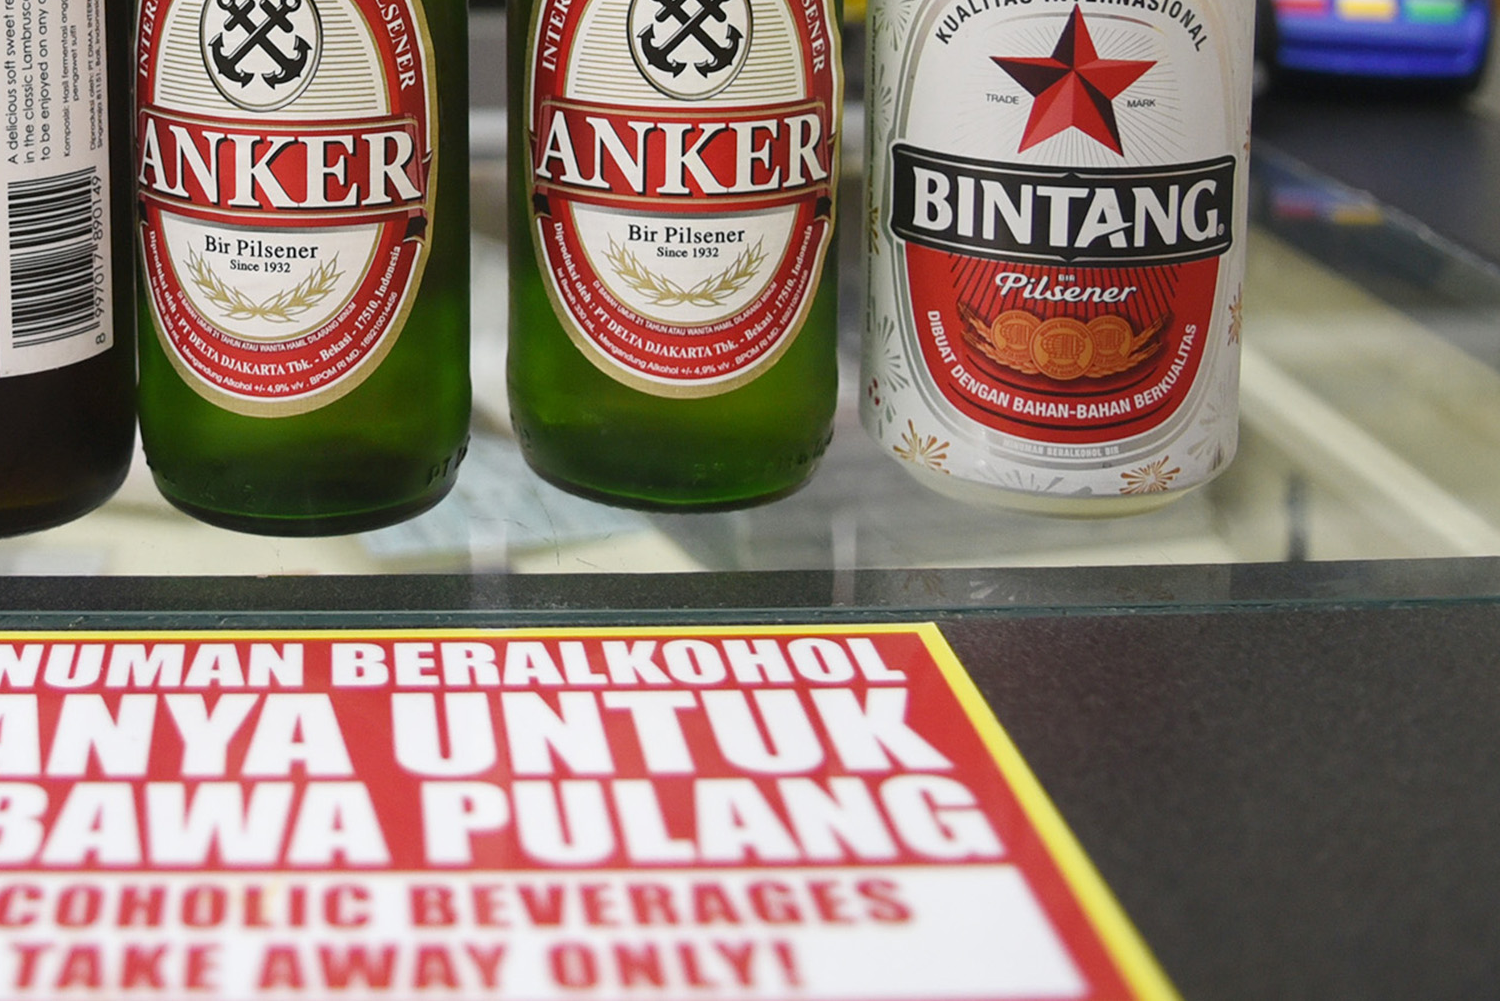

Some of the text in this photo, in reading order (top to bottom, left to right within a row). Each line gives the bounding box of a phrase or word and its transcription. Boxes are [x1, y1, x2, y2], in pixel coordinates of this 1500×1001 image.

[2, 14, 16, 56] sweet
[38, 8, 50, 35] any
[38, 39, 48, 58] on
[60, 26, 69, 79] fermentasi
[4, 60, 17, 86] soft
[37, 61, 52, 120] enjoyed
[72, 48, 80, 102] pengawet
[22, 74, 34, 120] classic
[986, 93, 1156, 109] TRADE MARK
[6, 88, 18, 150] delicious
[23, 124, 35, 148] the
[40, 123, 50, 143] be
[8, 154, 18, 164] A
[24, 151, 35, 164] in
[40, 147, 50, 162] to
[138, 117, 423, 209] ANKER
[536, 110, 828, 195] ANKER
[912, 166, 1218, 249] BINTANG
[204, 234, 318, 260] Bir Pilsener
[628, 224, 746, 245] Bir Pilsener
[656, 246, 719, 258] Since 1932
[230, 259, 291, 274] Since 1932
[995, 272, 1137, 303] Pilsener
[150, 230, 401, 376] Diproduksi oleh PT DELTA DJAKARTA Tbk. Bekasi 17510, Indonesia
[554, 222, 578, 282] Diproduksi
[574, 280, 591, 304] oleh
[593, 306, 610, 323] PT
[607, 319, 643, 350] DELTA
[644, 338, 713, 358] DJAKARTA
[712, 339, 738, 356] Tbk.
[744, 310, 774, 342] Bekasi
[792, 225, 813, 276] Indonesia
[182, 345, 224, 384] Mengandung
[309, 366, 338, 386] BPOM
[336, 362, 348, 372] RI
[598, 333, 647, 370] Mengandung
[647, 358, 680, 374] Alkohol
[927, 310, 956, 364] DIBUAT
[950, 362, 1010, 409] DENGAN
[1012, 396, 1132, 420] BAHAN-BAHAN
[1133, 324, 1198, 409] BERKUALITAS
[330, 638, 907, 688] BERALKOHOL
[391, 687, 955, 777] UNTUK
[420, 775, 1007, 865] PULANG
[409, 878, 916, 928] BEVERAGES
[11, 940, 803, 992] TAKE AWAY ONLY!
